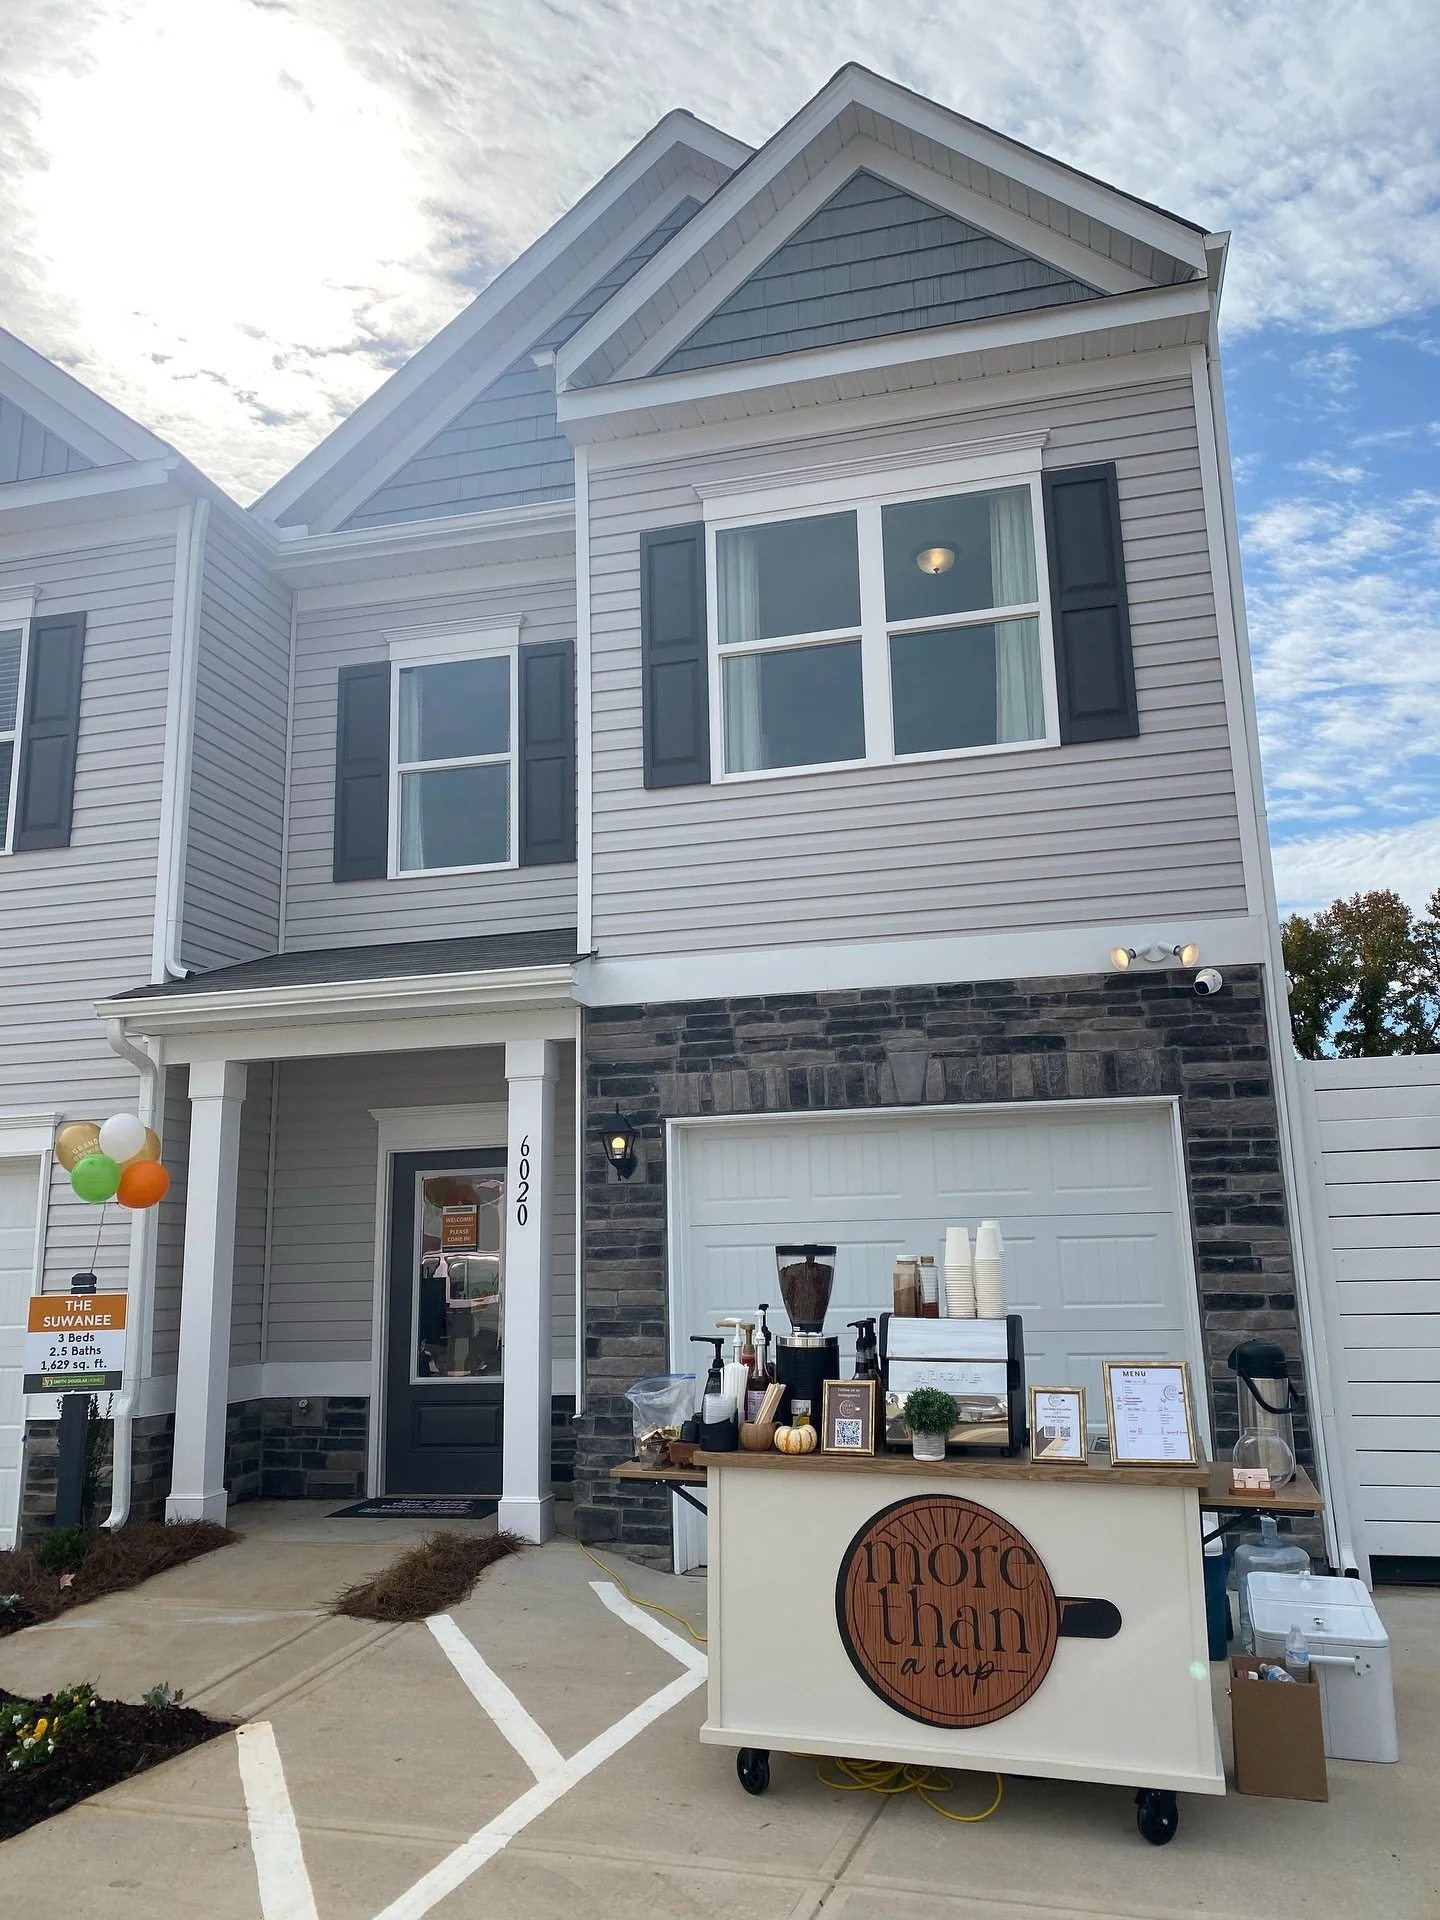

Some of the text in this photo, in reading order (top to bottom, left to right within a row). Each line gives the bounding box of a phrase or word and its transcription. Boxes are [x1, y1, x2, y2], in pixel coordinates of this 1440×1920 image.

[72, 1138, 98, 1154] GRAND
[516, 1134, 530, 1226] 6020
[65, 1300, 92, 1311] THE
[43, 1314, 112, 1327] SUWANEE
[58, 1333, 95, 1342] 3 Beds
[49, 1346, 102, 1356] 2.5 Baths
[40, 1359, 107, 1371] 1,629 sq. ft.
[862, 1540, 1036, 1590] more
[868, 1586, 1031, 1654] than
[900, 1657, 1002, 1696] a cup
